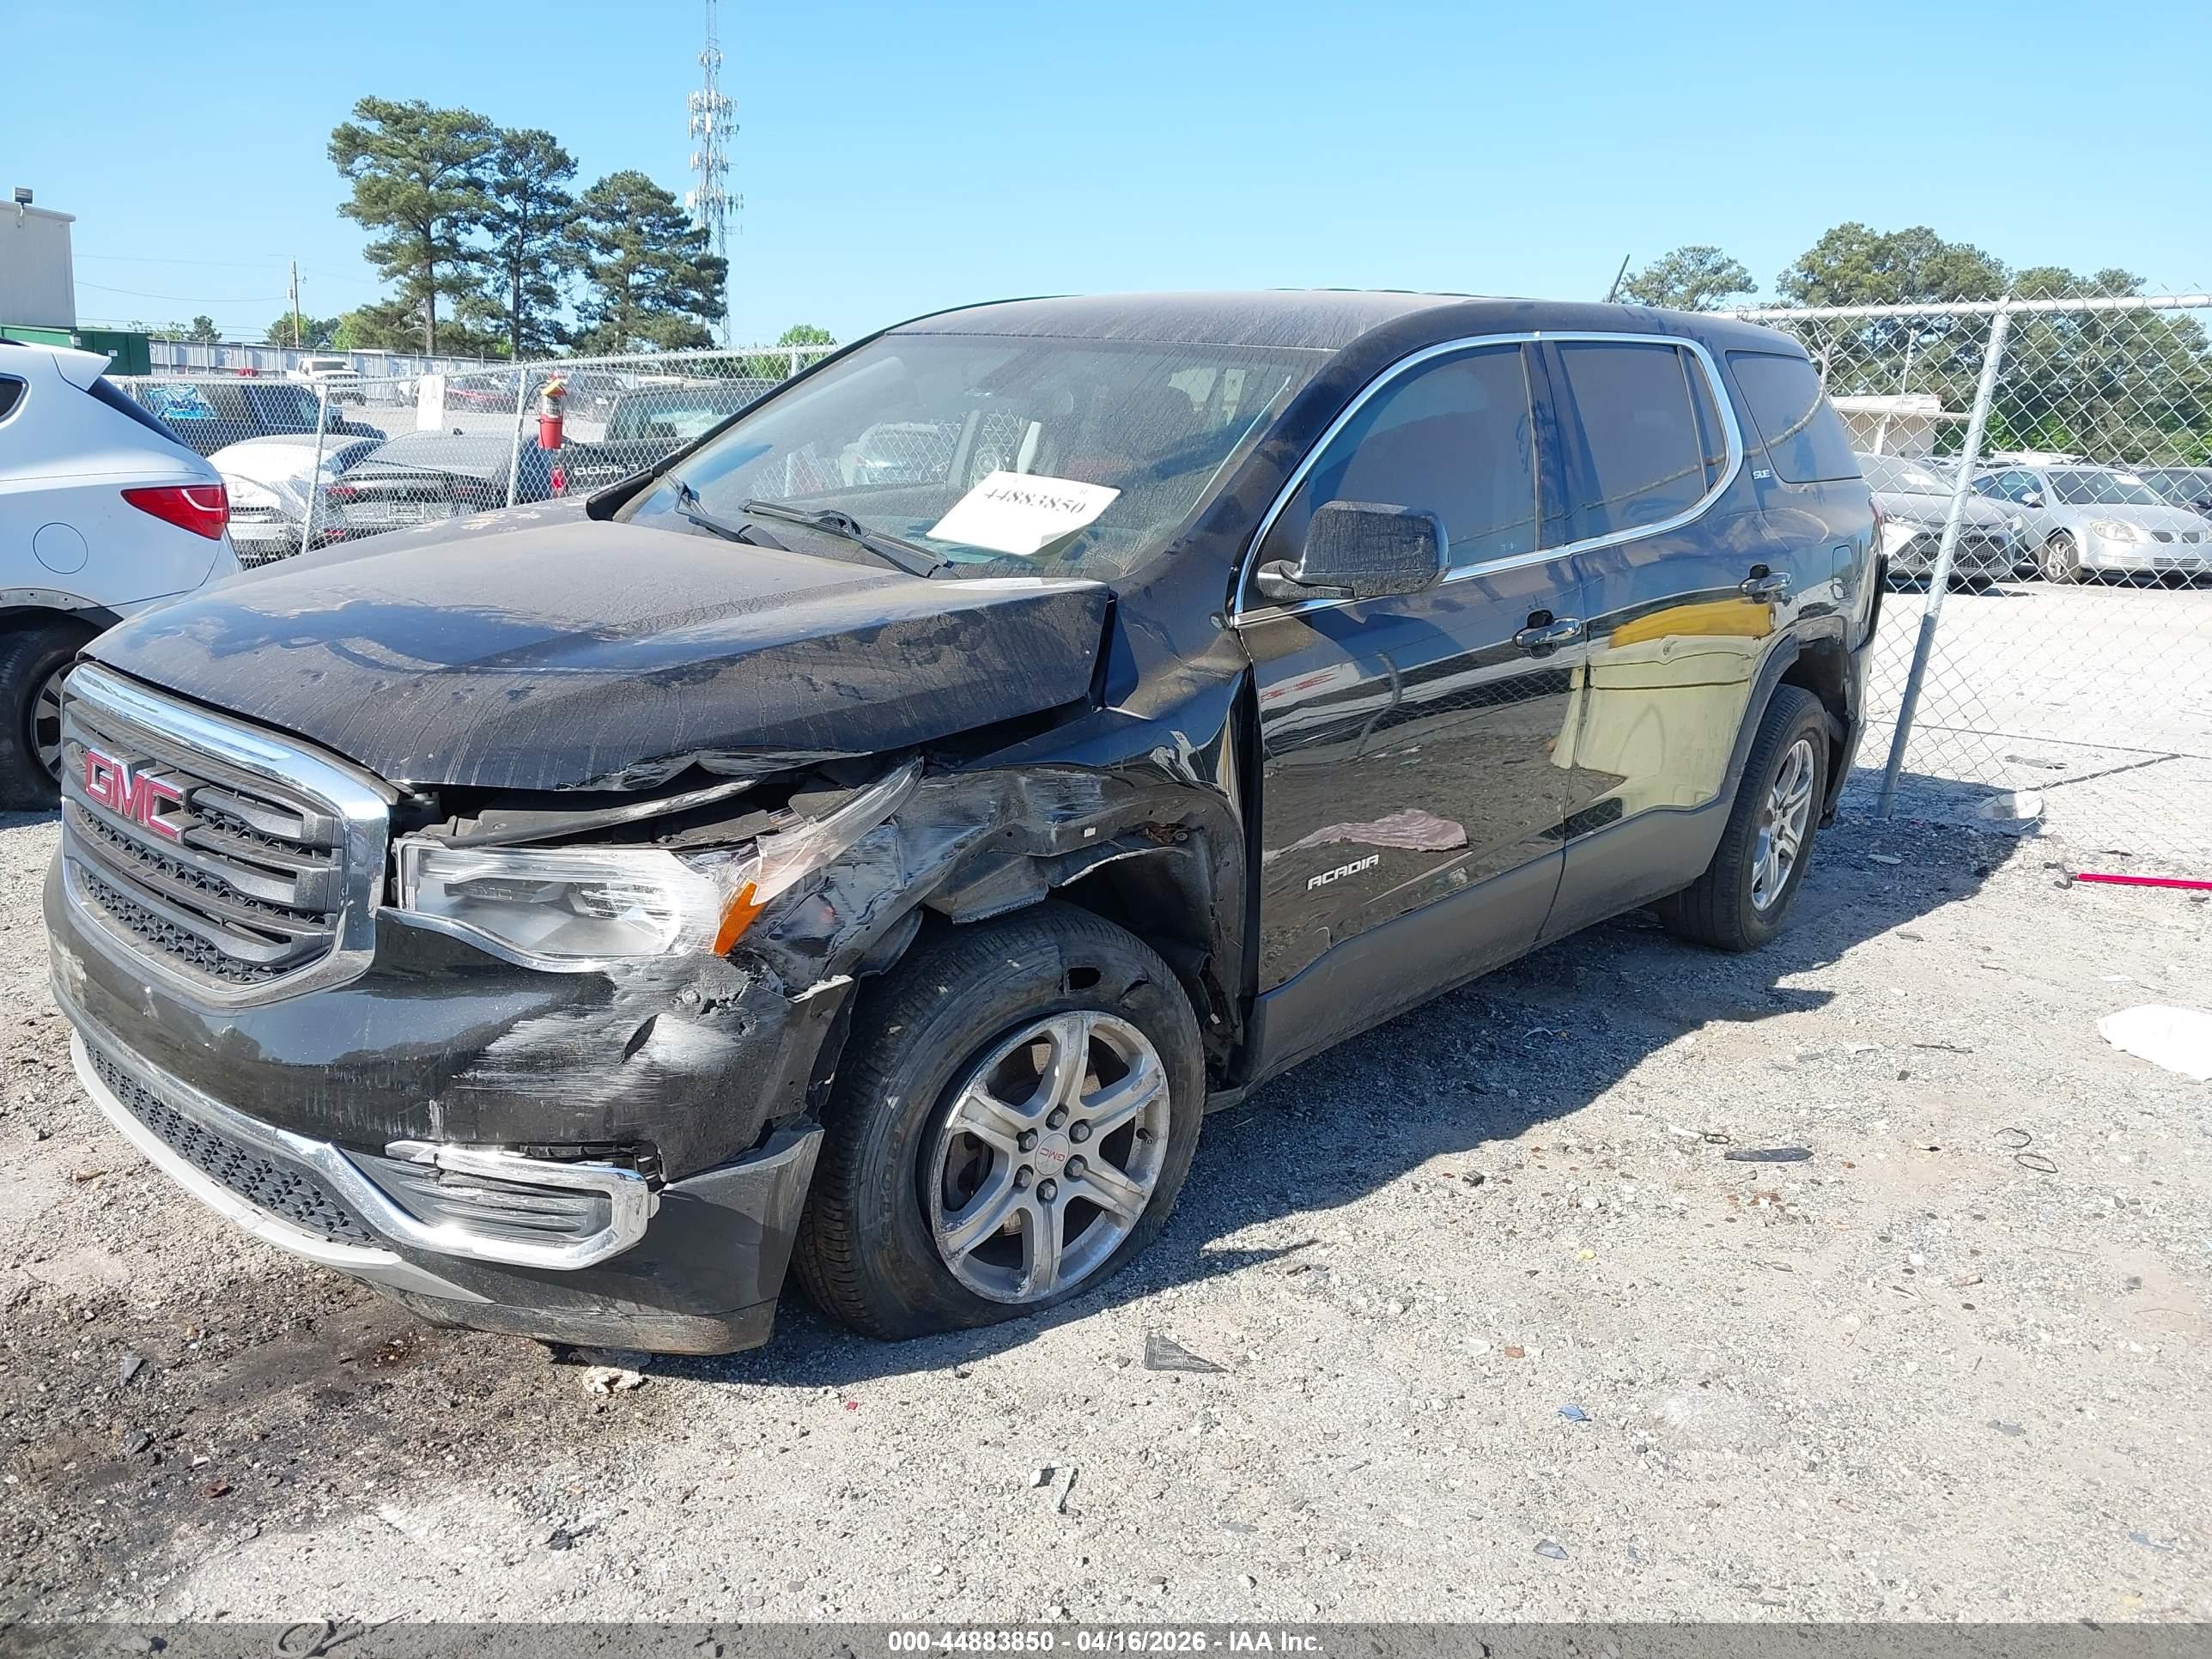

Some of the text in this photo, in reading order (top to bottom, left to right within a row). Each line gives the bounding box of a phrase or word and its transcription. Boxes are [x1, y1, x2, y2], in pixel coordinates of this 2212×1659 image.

[984, 488, 1086, 514] 44883850
[85, 747, 186, 845] GMC
[1306, 854, 1380, 890] ACADIA
[1040, 1147, 1066, 1162] GMC
